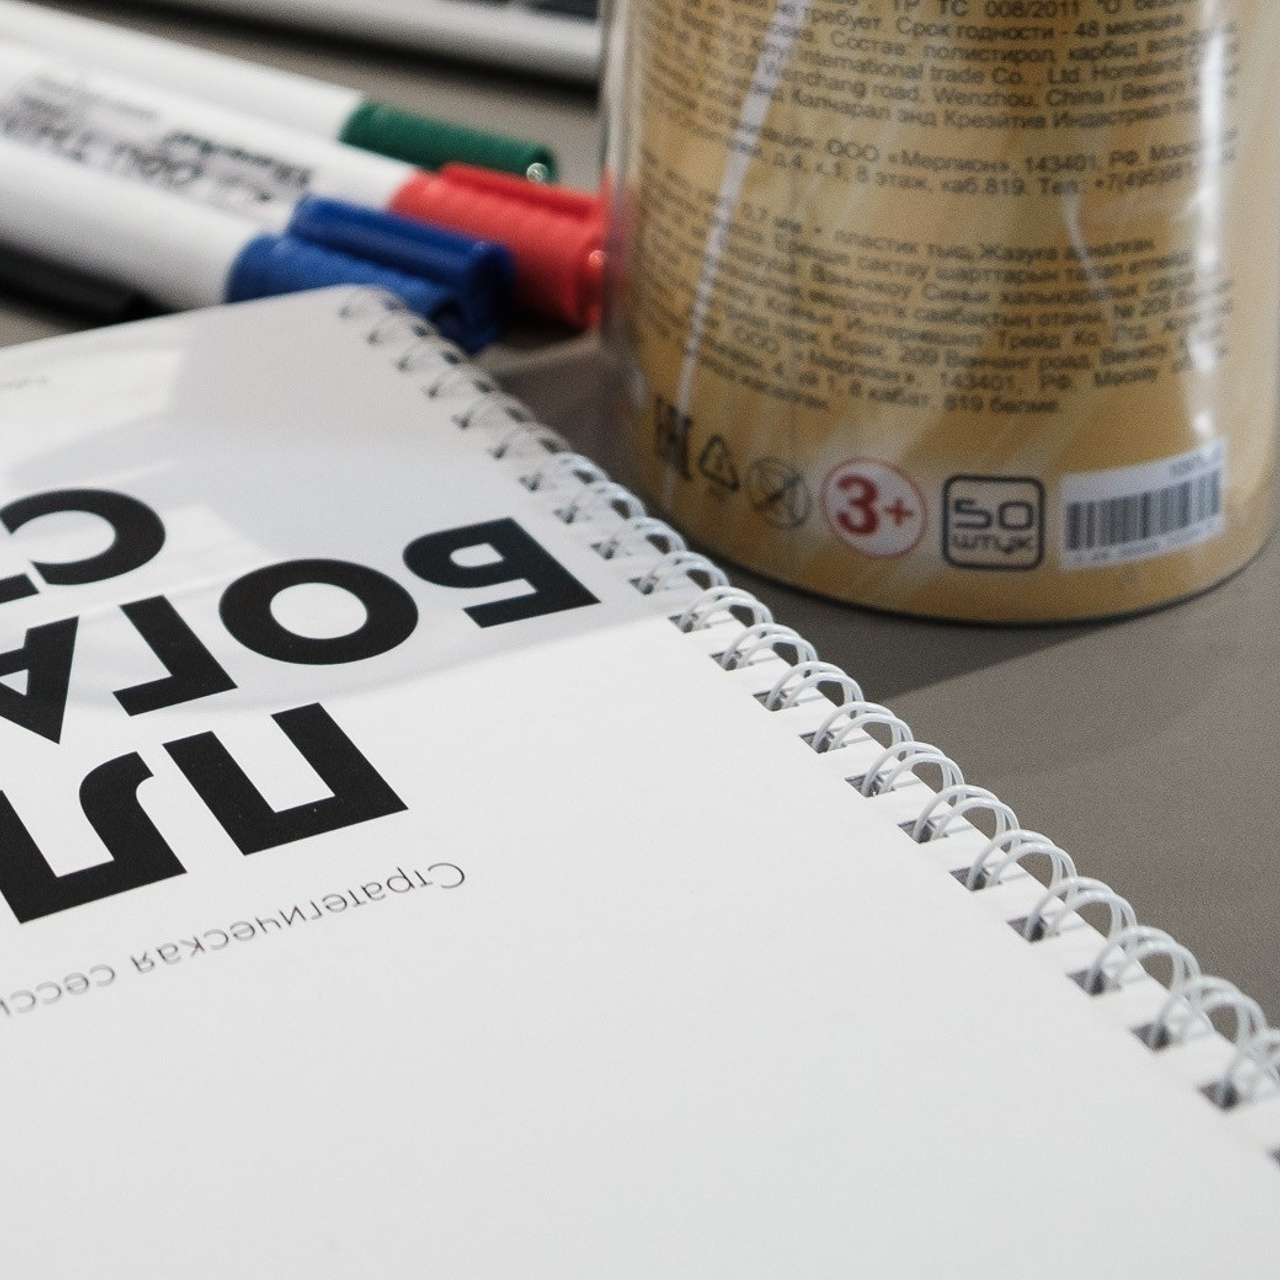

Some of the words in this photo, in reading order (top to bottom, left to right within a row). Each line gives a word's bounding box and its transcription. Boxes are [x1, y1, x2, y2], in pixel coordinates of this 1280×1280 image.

[895, 15, 950, 40] Срок
[956, 23, 1055, 42] годности
[1075, 22, 1099, 38] 48
[928, 65, 984, 84] trade
[1045, 87, 1105, 108] China
[825, 137, 880, 163] ООО
[834, 472, 915, 537] 3+
[954, 497, 1034, 531] 50
[128, 859, 468, 978] Стратегическая
